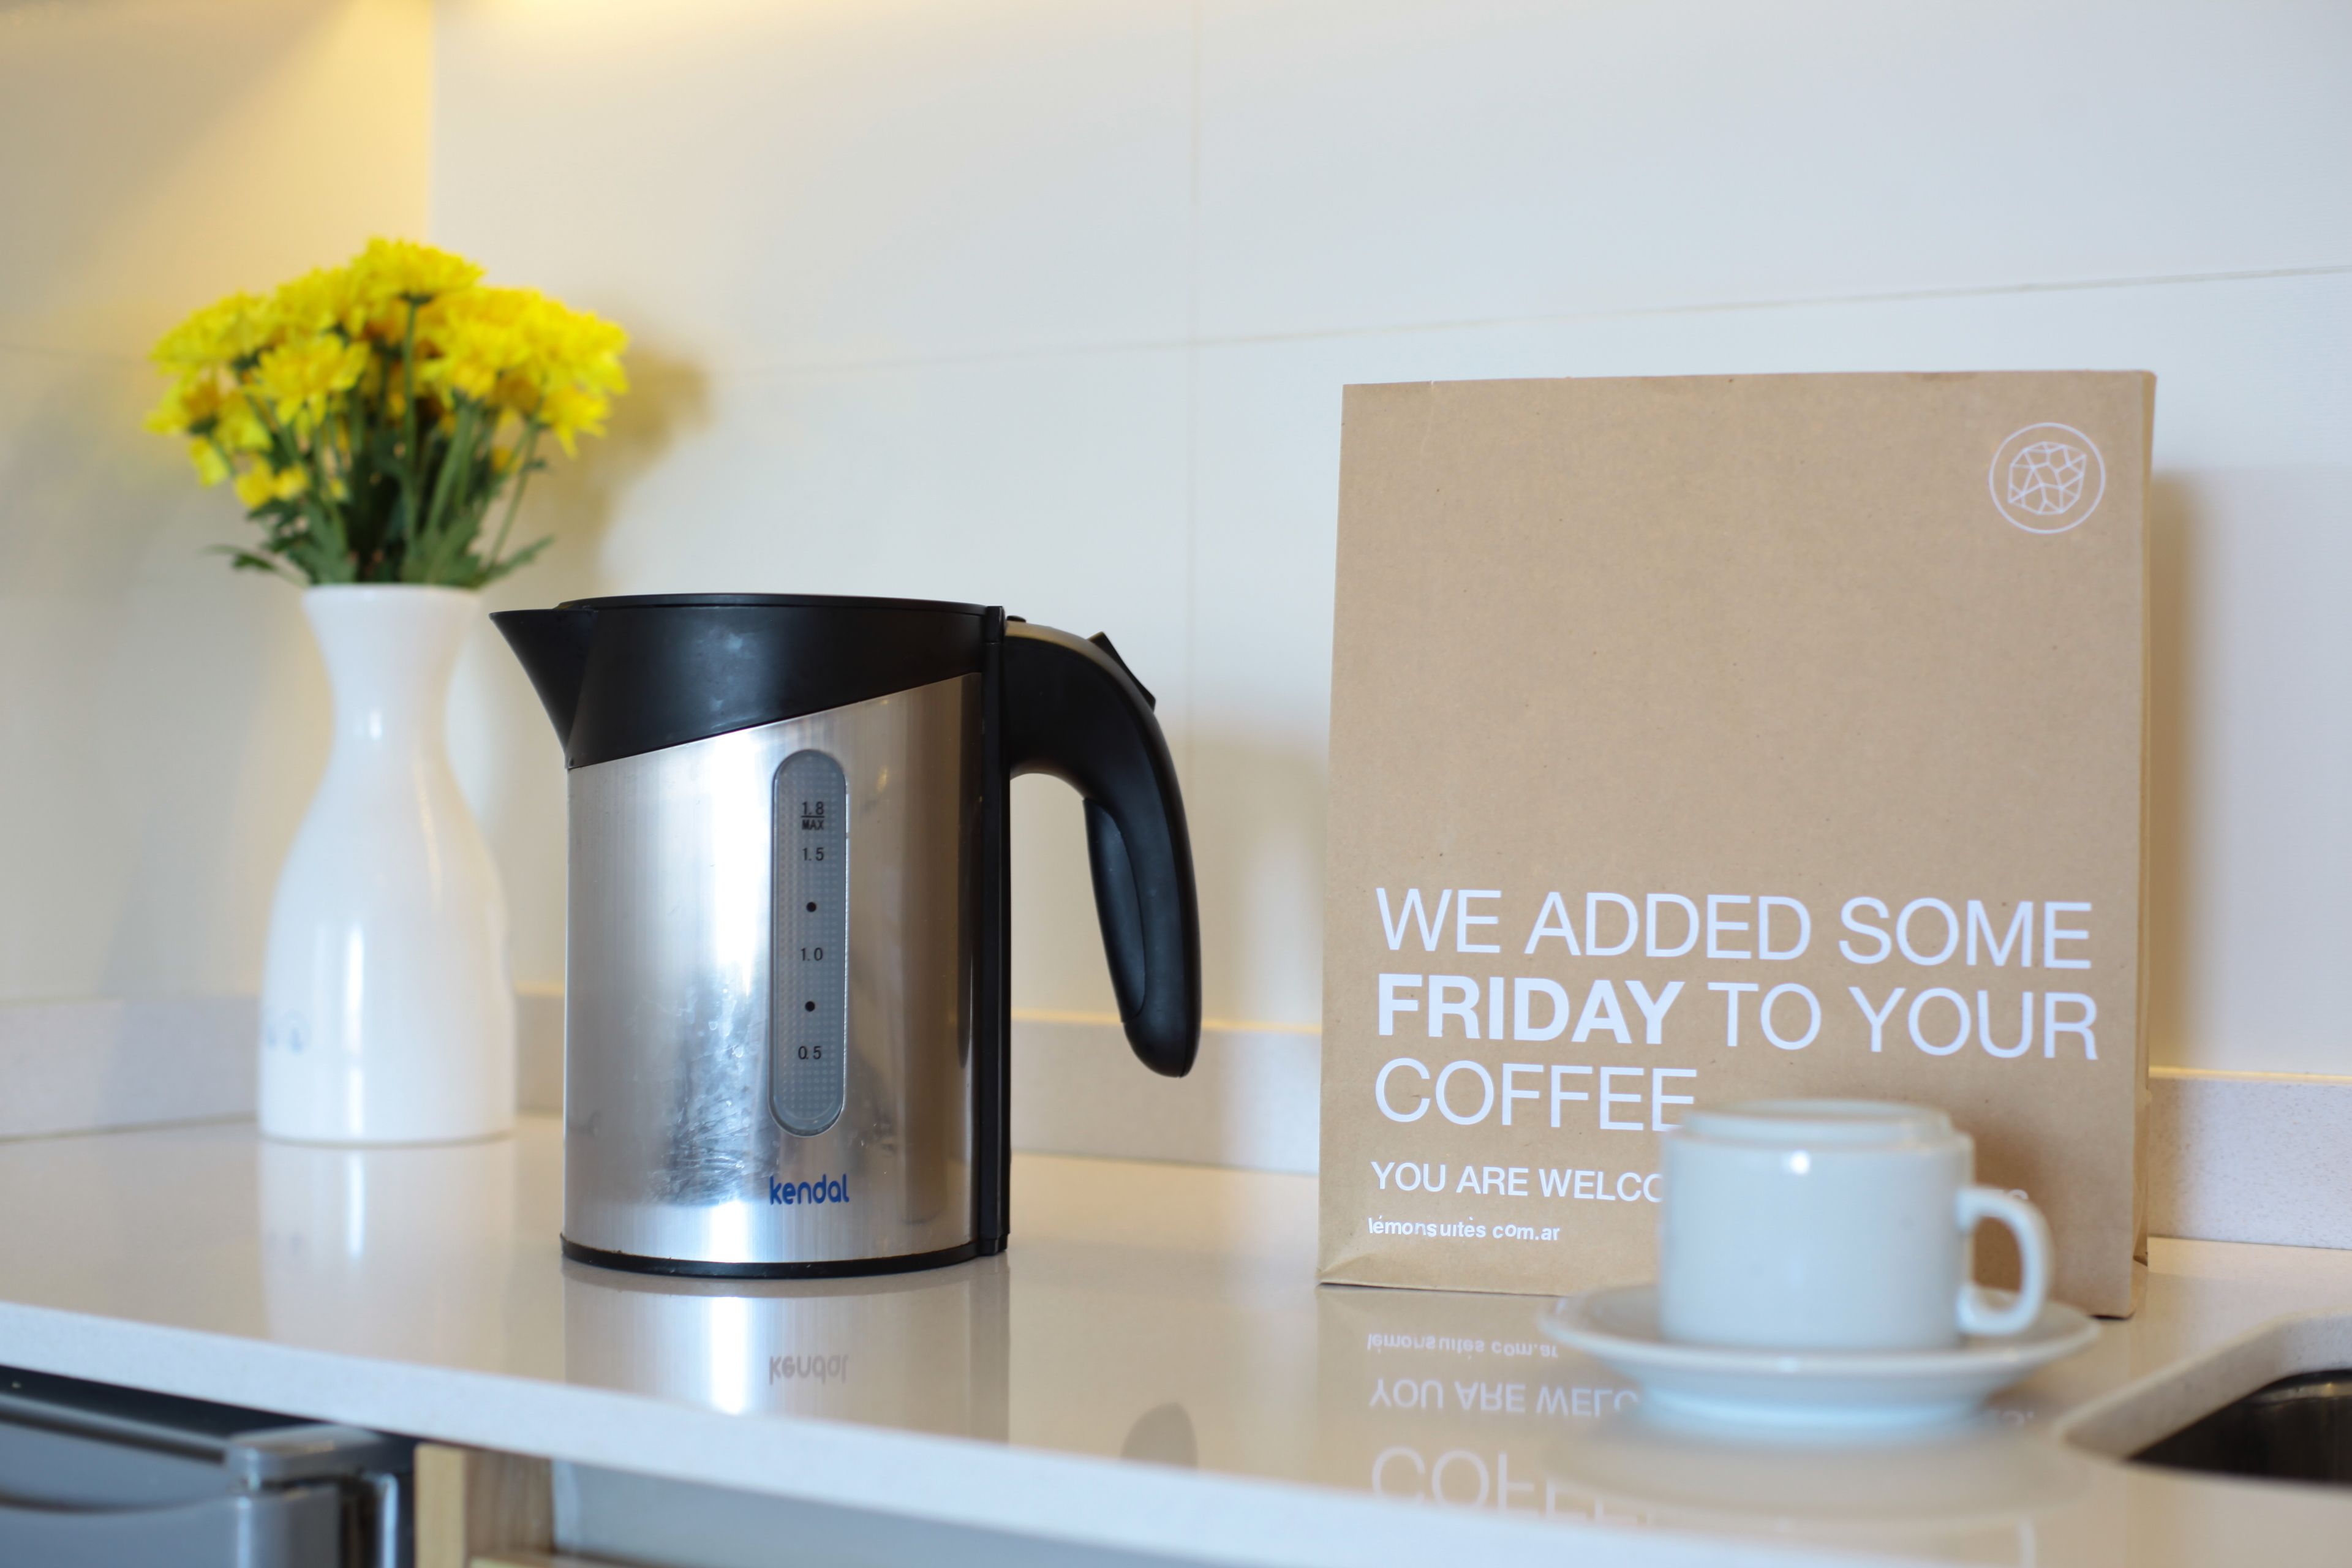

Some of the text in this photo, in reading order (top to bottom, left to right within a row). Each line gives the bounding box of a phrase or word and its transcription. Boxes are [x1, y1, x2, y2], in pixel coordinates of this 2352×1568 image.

[802, 801, 824, 815] 1.8
[802, 819, 824, 831] MAX
[802, 846, 825, 862] 1.5
[1375, 887, 2092, 970] WE ADDED SOME
[800, 947, 824, 962] 1.0
[1378, 973, 2098, 1060] FRIDAY TO YOUR
[797, 1046, 822, 1060] 0.5
[1374, 1057, 1697, 1132] COFFEE
[769, 1174, 850, 1205] kendal
[1371, 1161, 1665, 1203] YOU ARE WELCO
[1492, 1224, 1561, 1241] com.ar
